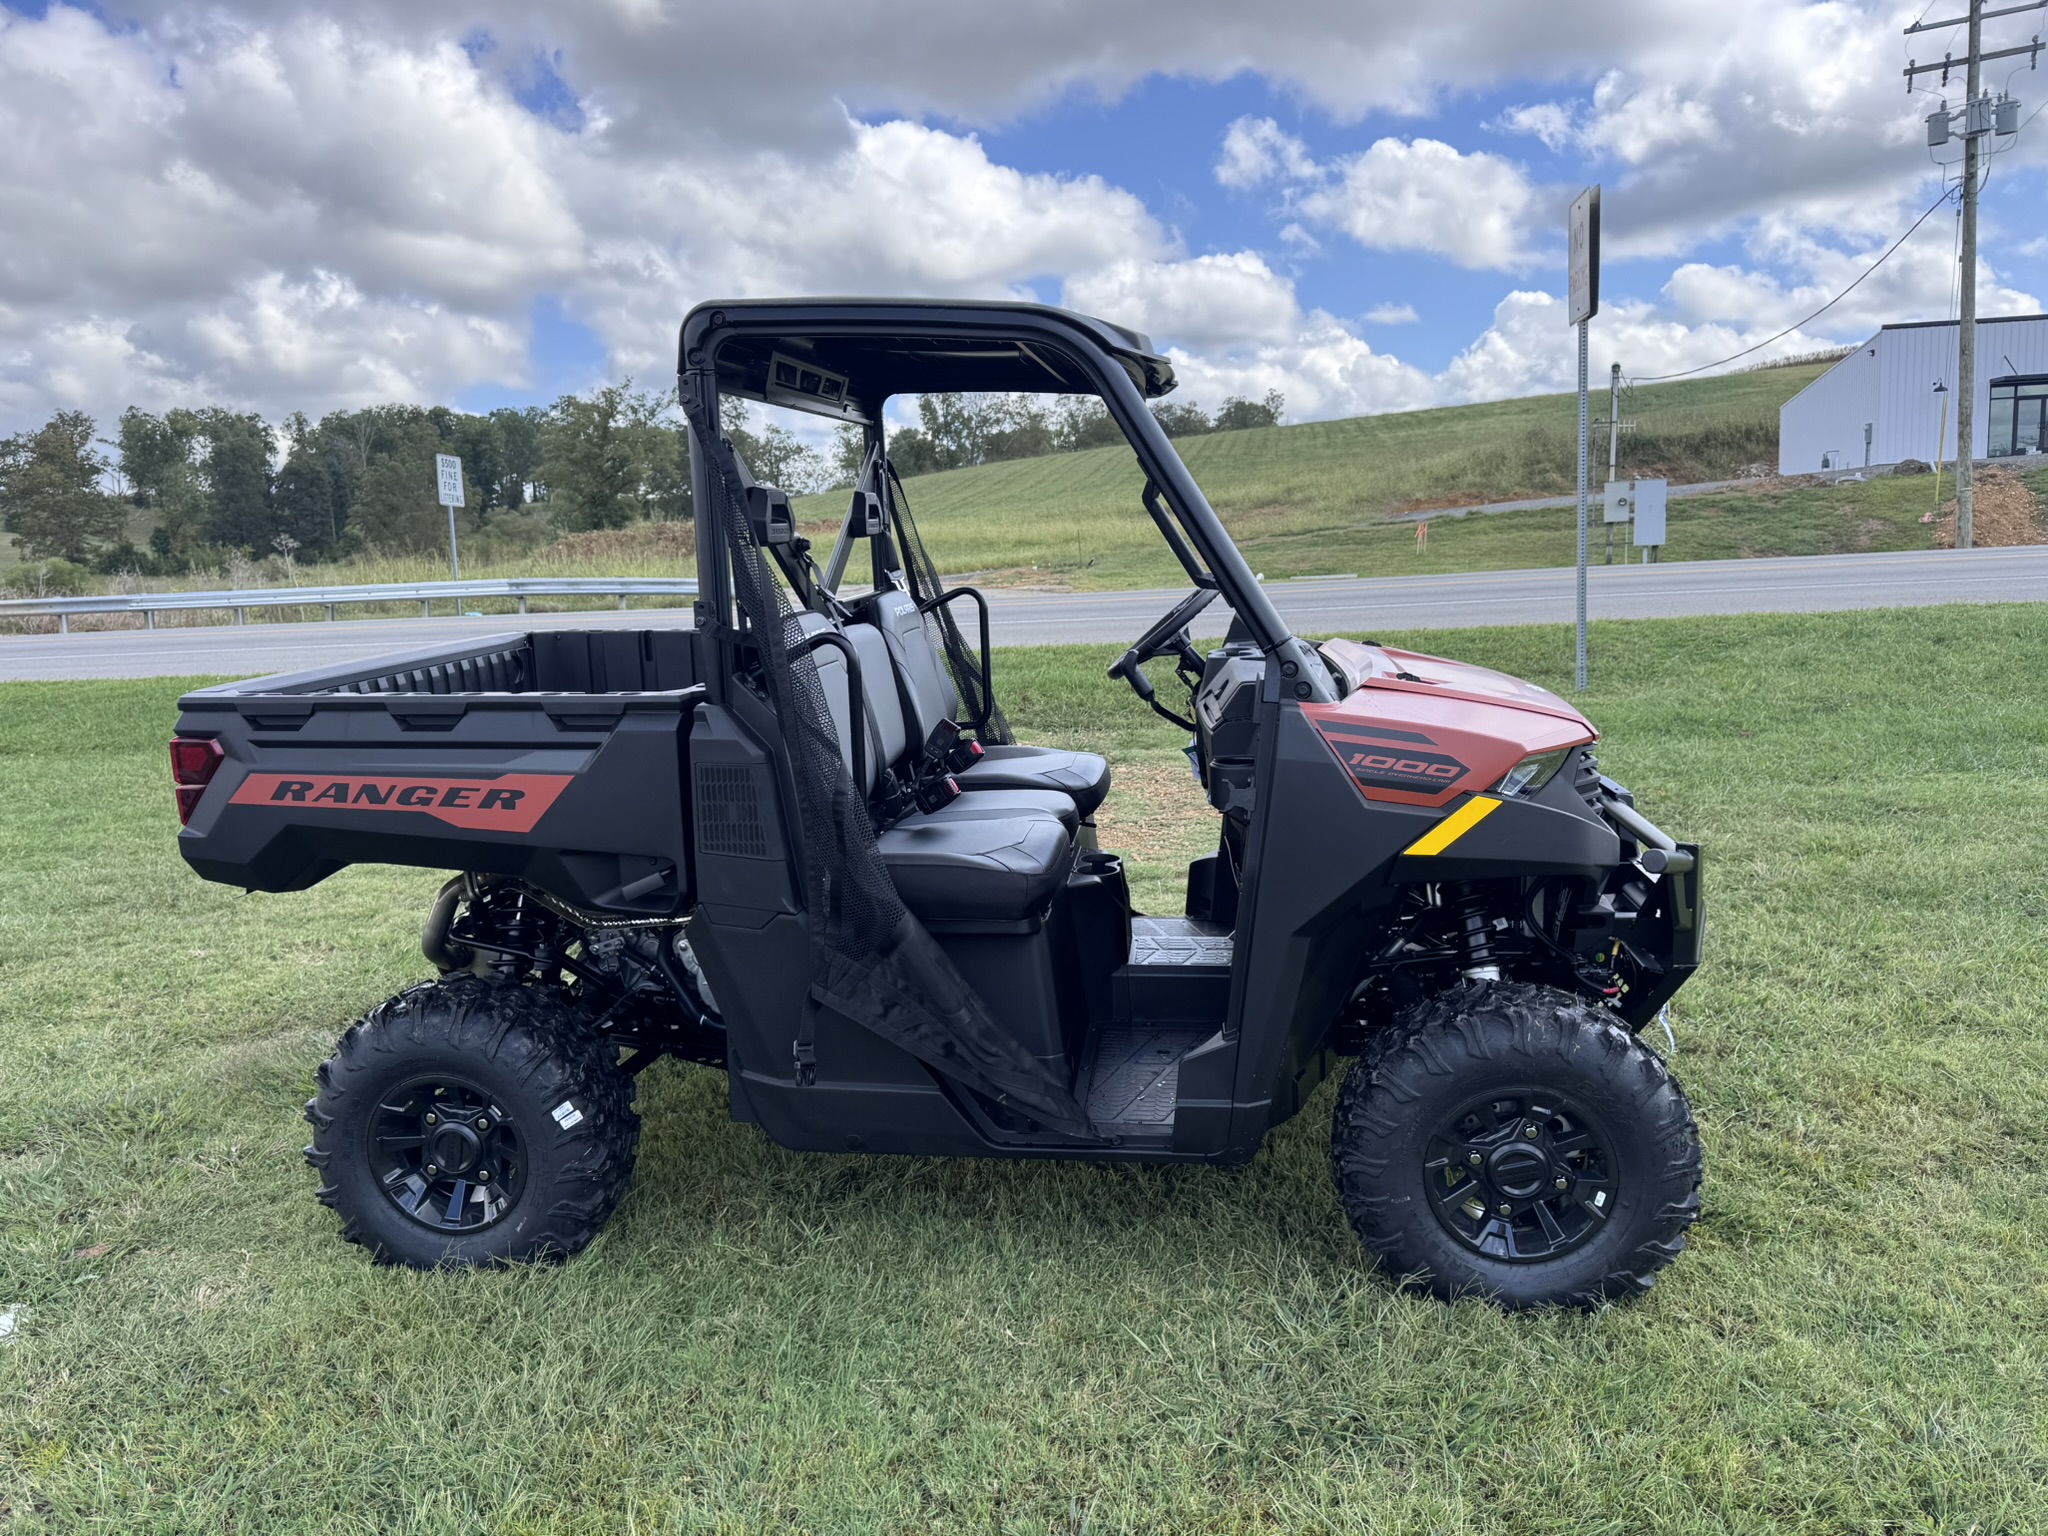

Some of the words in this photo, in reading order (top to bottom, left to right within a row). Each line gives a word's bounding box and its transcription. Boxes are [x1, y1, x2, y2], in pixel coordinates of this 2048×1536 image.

[1573, 221, 1584, 256] NO
[441, 457, 456, 469] $500
[441, 469, 458, 482] FINE
[443, 481, 457, 492] FOR
[894, 603, 915, 617] POLARIS
[1349, 753, 1460, 778] 1000
[1355, 767, 1385, 775] SINGLE
[270, 781, 526, 811] RANGER
